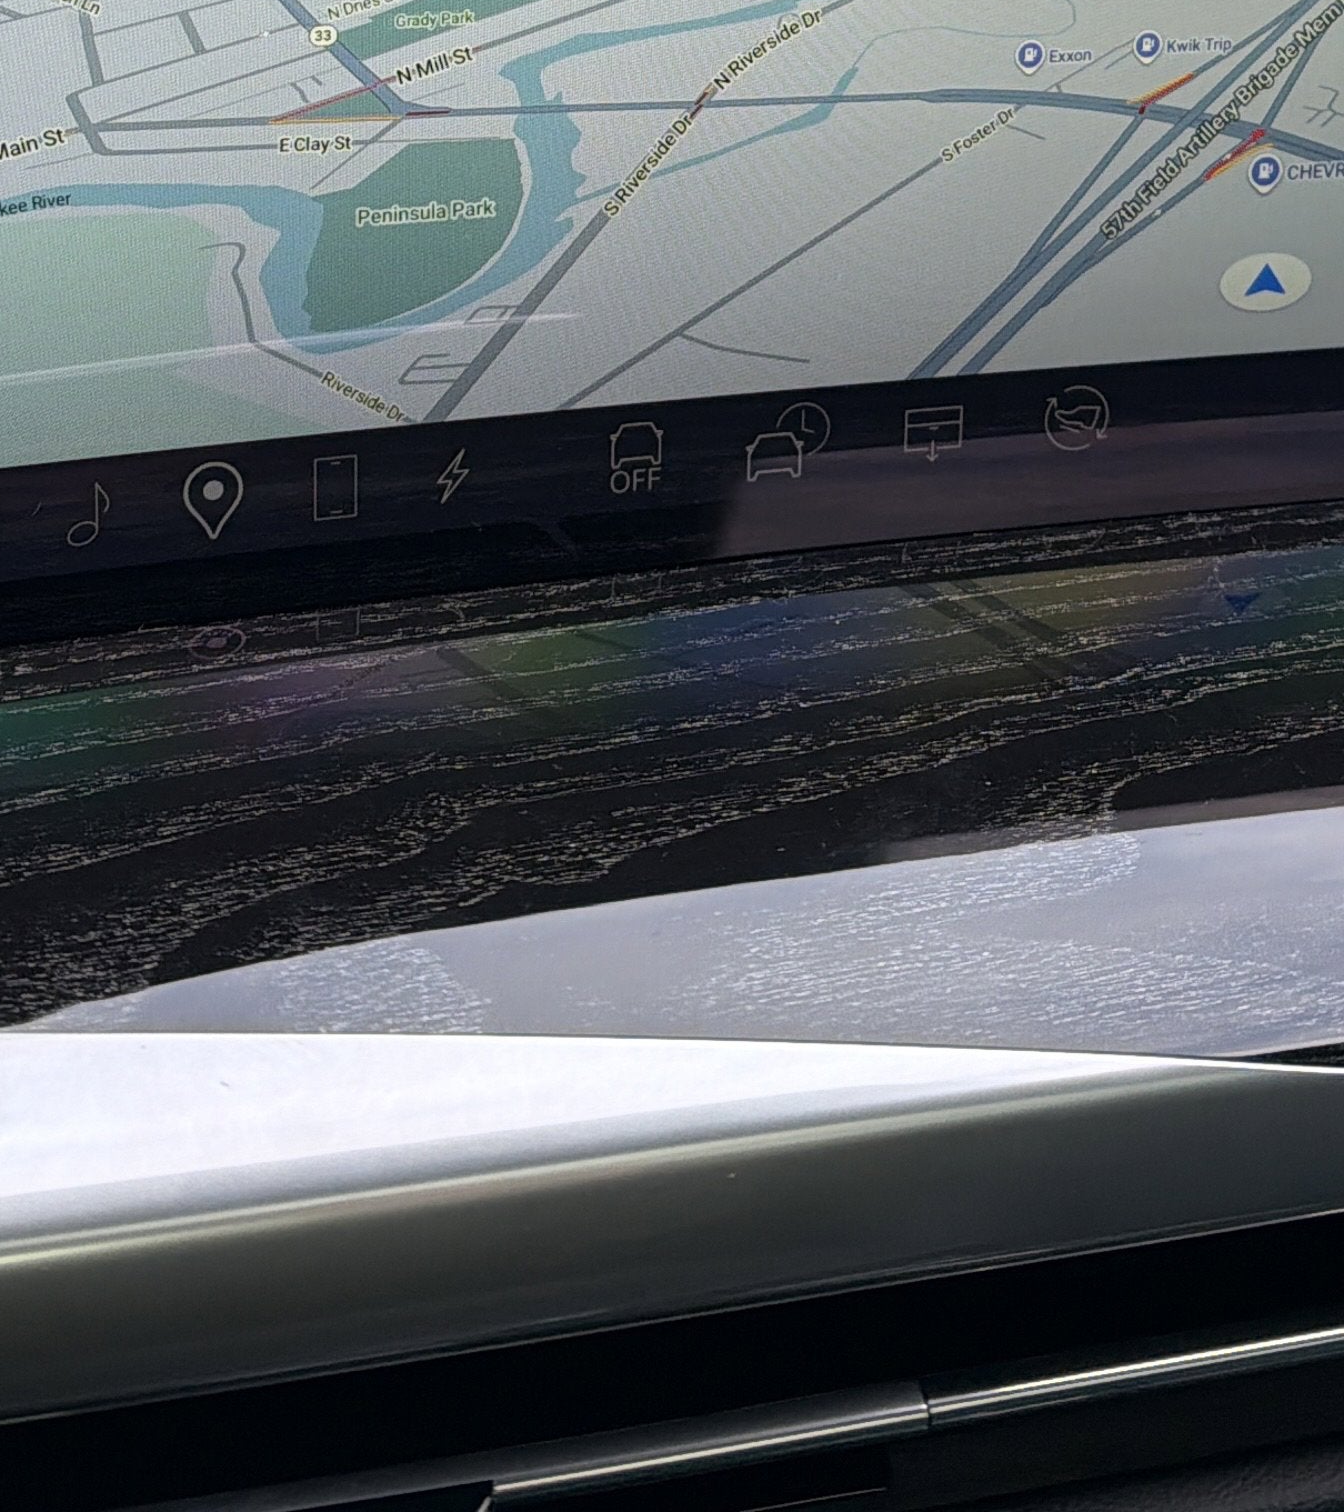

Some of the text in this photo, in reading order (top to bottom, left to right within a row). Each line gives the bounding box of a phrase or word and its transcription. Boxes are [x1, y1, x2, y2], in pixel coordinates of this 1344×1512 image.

[327, 6, 341, 21] N
[395, 10, 474, 28] Grady Park
[314, 29, 332, 42] 33
[1167, 38, 1233, 54] Kwik Trip
[714, 8, 823, 90] N Riverside Dr
[1049, 49, 1093, 64] Exxon
[397, 46, 474, 85] N Mill St
[1100, 199, 1143, 241] 57th
[1138, 155, 1180, 204] Field
[1176, 99, 1240, 168] Artillery
[1234, 40, 1299, 107] Brigade
[1292, 2, 1343, 48] Mem
[42, 129, 65, 147] St
[279, 136, 352, 154] E Clay St
[941, 108, 1015, 163] S Foster Dr
[604, 115, 692, 217] S Riverside Dr
[32, 192, 73, 210] River
[358, 200, 496, 226] Peninsula Park
[321, 371, 405, 422] Riverside Dr
[611, 467, 662, 493] OFF
